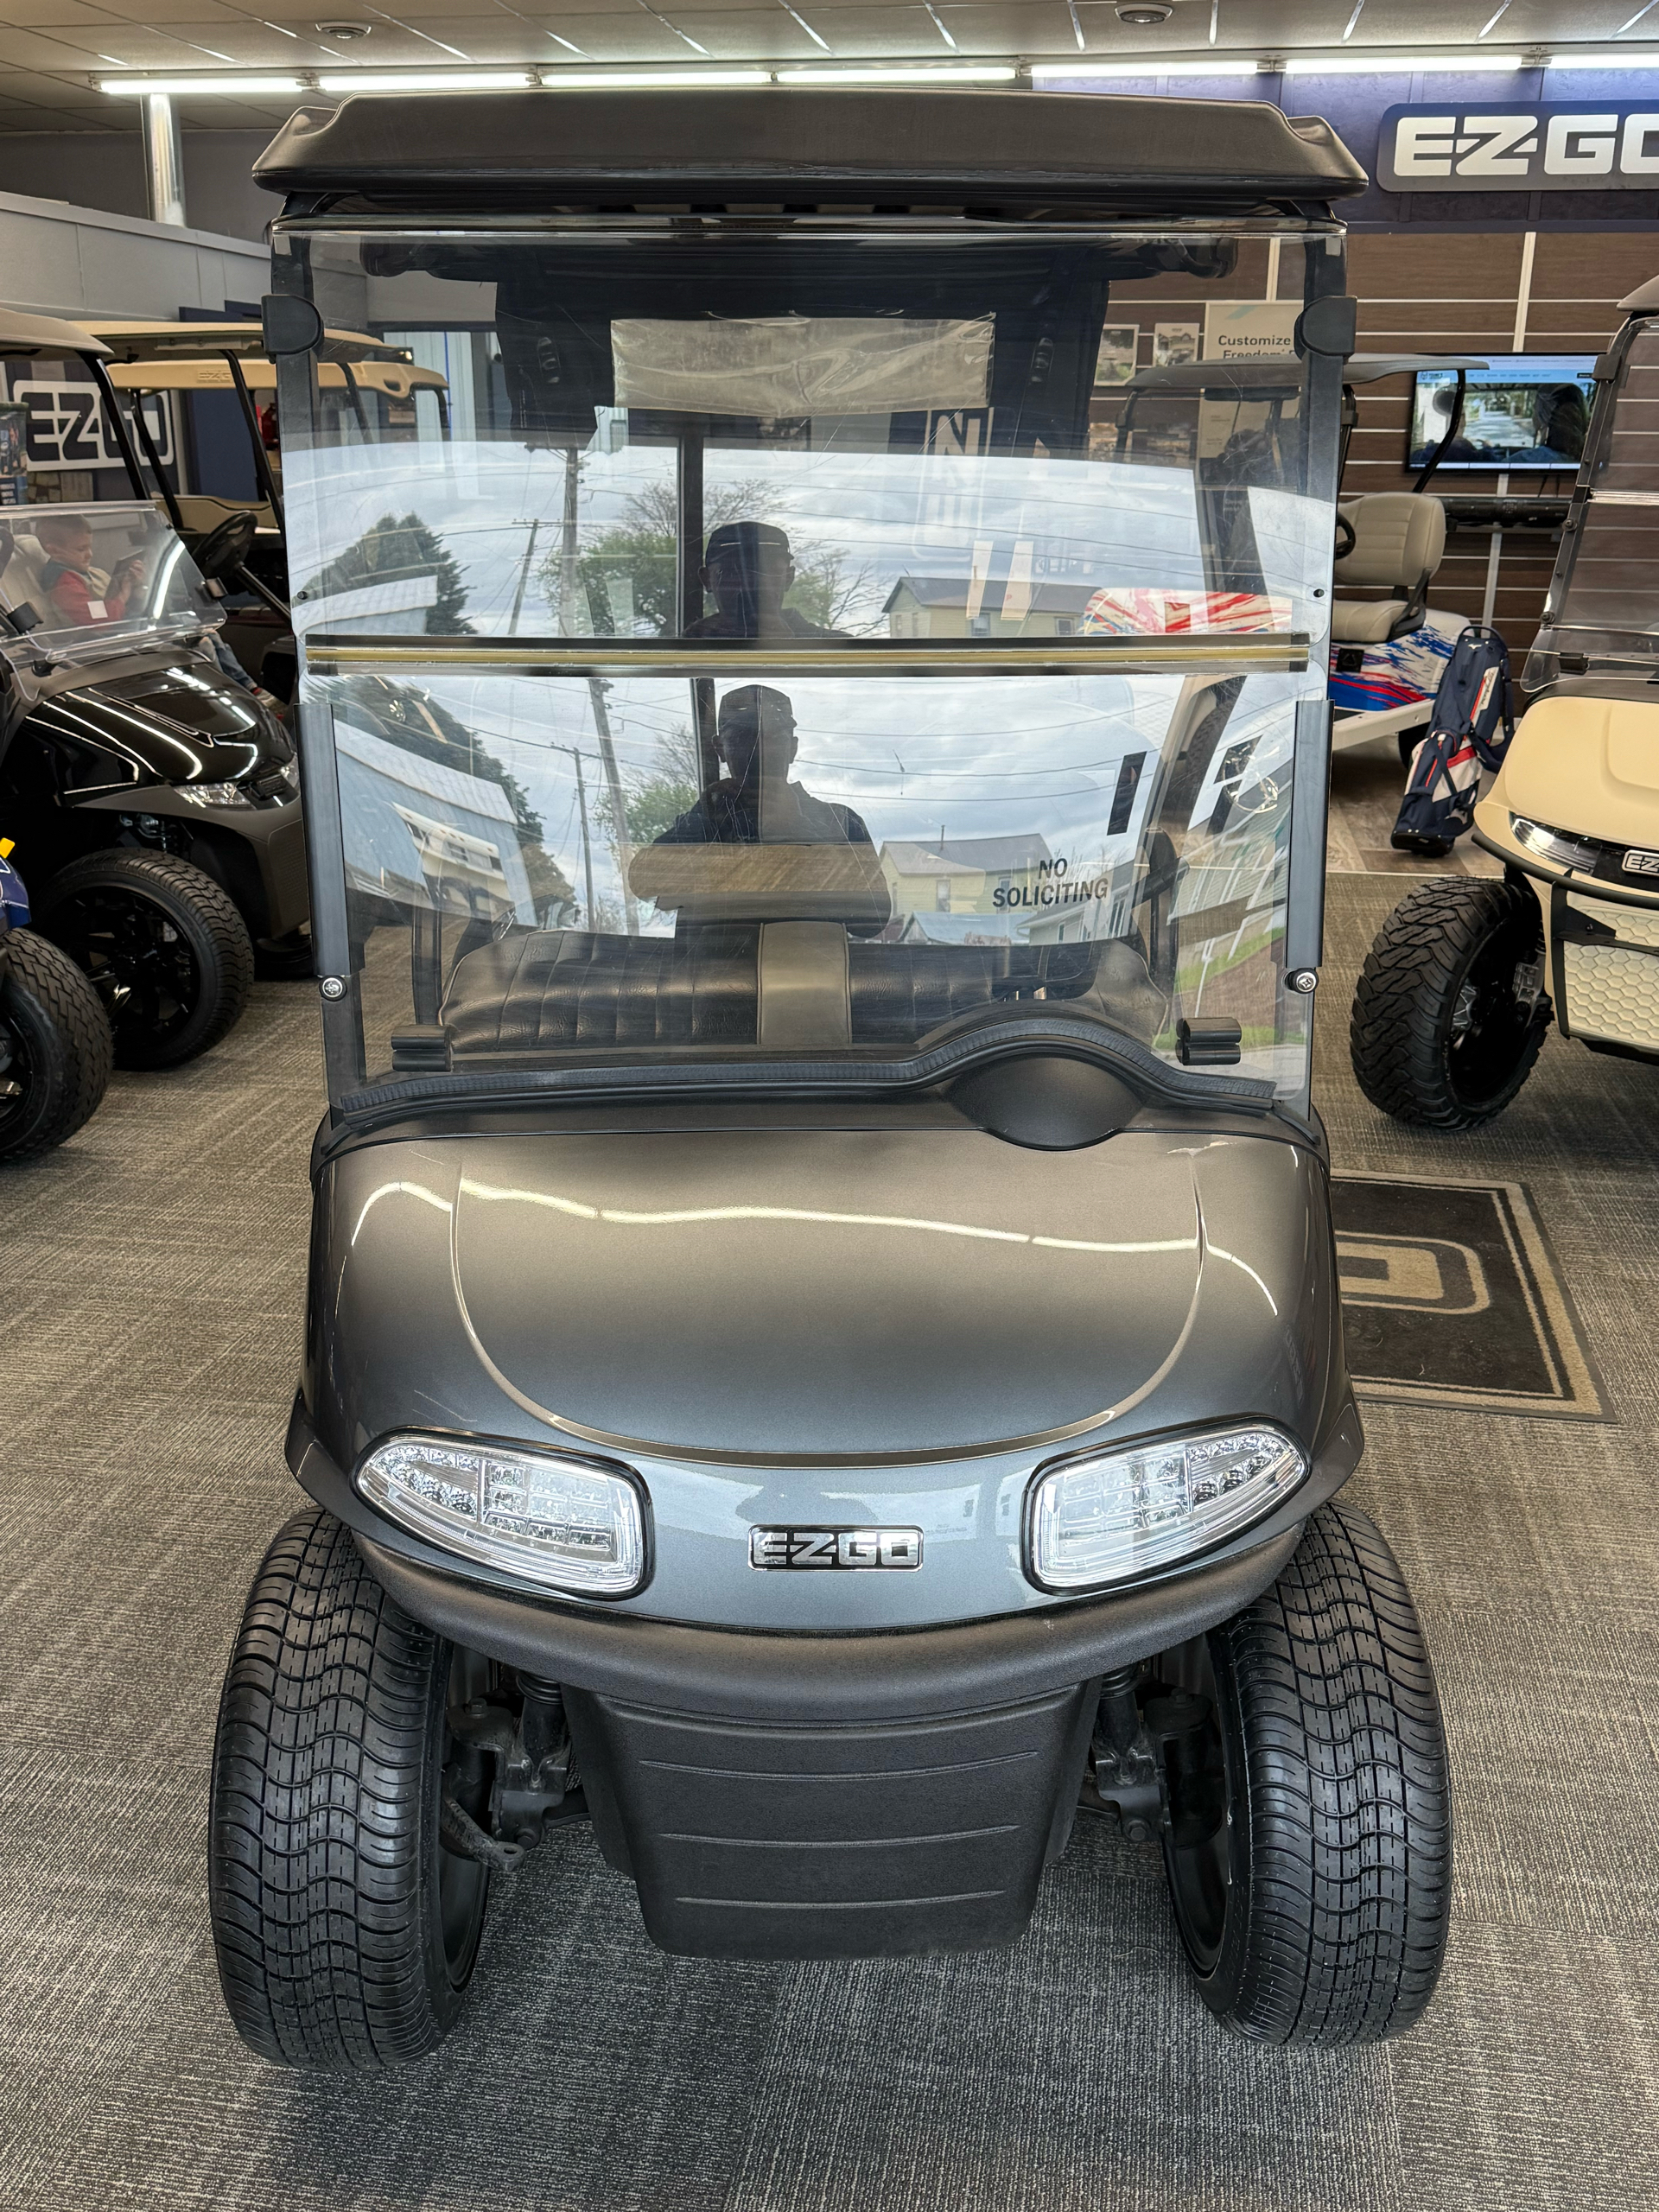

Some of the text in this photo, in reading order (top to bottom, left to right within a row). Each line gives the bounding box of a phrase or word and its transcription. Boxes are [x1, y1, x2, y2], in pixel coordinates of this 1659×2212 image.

[1218, 334, 1291, 346] Customize
[1039, 857, 1068, 880] NO
[992, 877, 1109, 907] SOLICITING
[753, 1532, 919, 1566] EZGO
